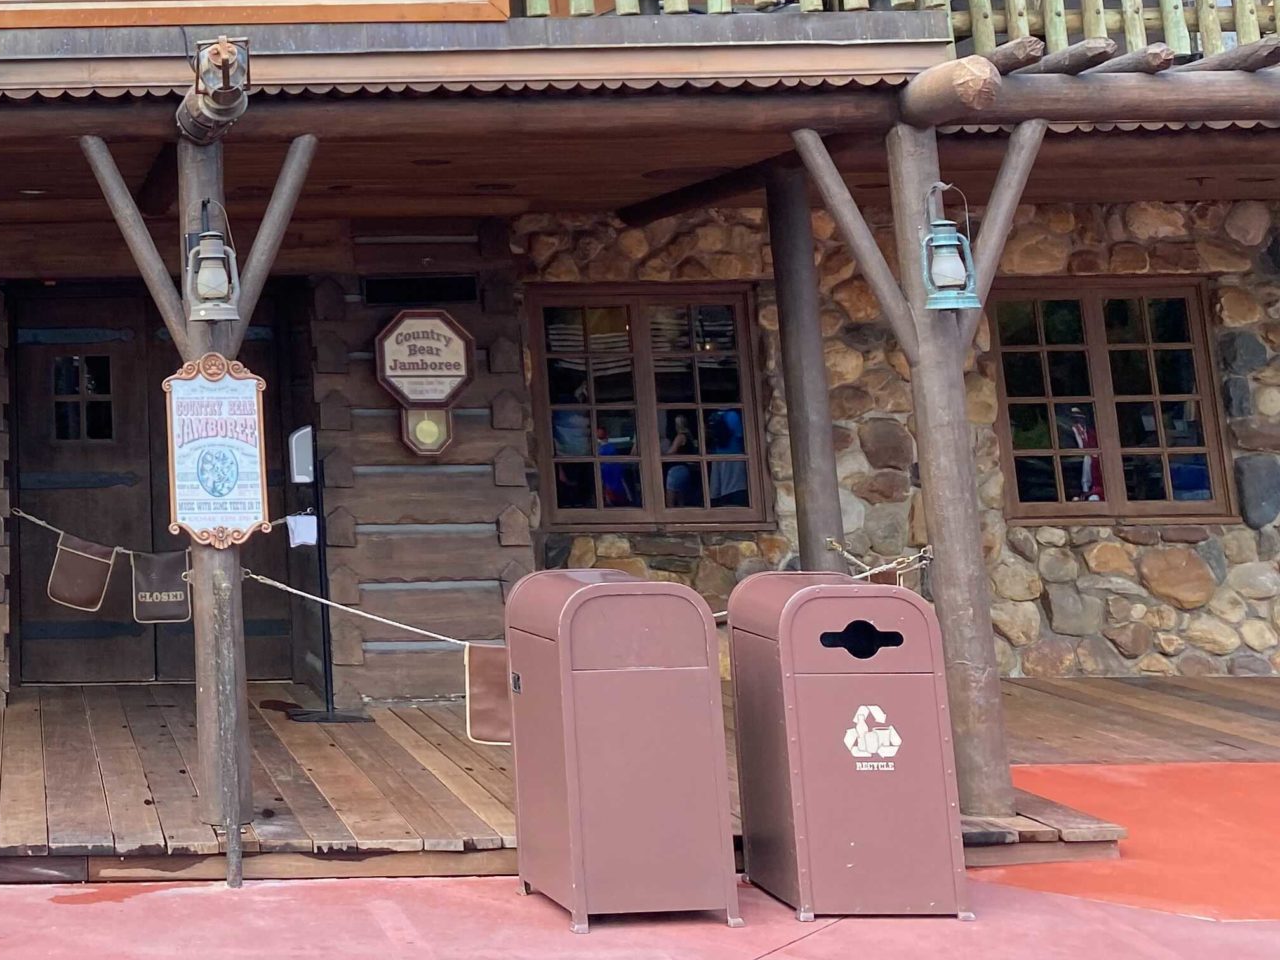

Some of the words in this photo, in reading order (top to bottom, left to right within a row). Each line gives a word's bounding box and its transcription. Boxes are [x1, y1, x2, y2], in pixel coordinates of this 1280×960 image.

[395, 330, 453, 347] Country
[407, 343, 442, 357] Bear
[389, 359, 462, 372] Jamboree
[176, 401, 223, 416] COUNTRY
[228, 400, 256, 415] BEAR
[176, 417, 257, 448] JAMBOREE
[197, 502, 211, 511] WITH
[138, 591, 184, 602] CLOSED
[856, 762, 895, 771] RECYCLE
